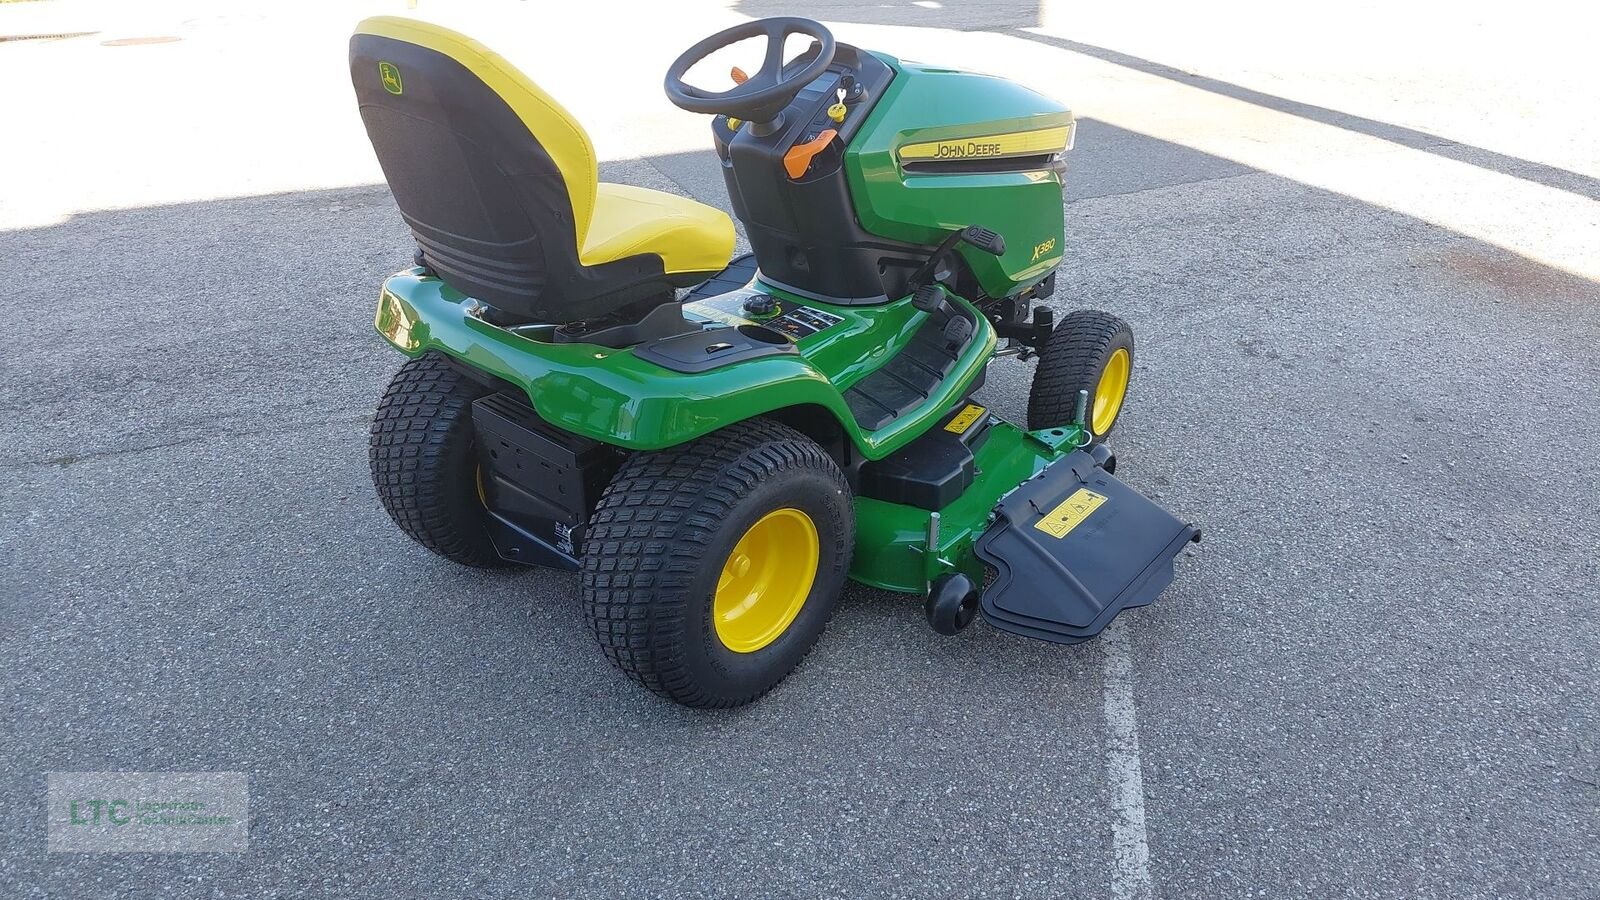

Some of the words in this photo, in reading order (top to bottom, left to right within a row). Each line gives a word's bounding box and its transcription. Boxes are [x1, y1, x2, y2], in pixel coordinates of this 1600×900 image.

[933, 143, 965, 156] JOHN
[967, 142, 1001, 155] DEERE
[1031, 238, 1056, 261] X380
